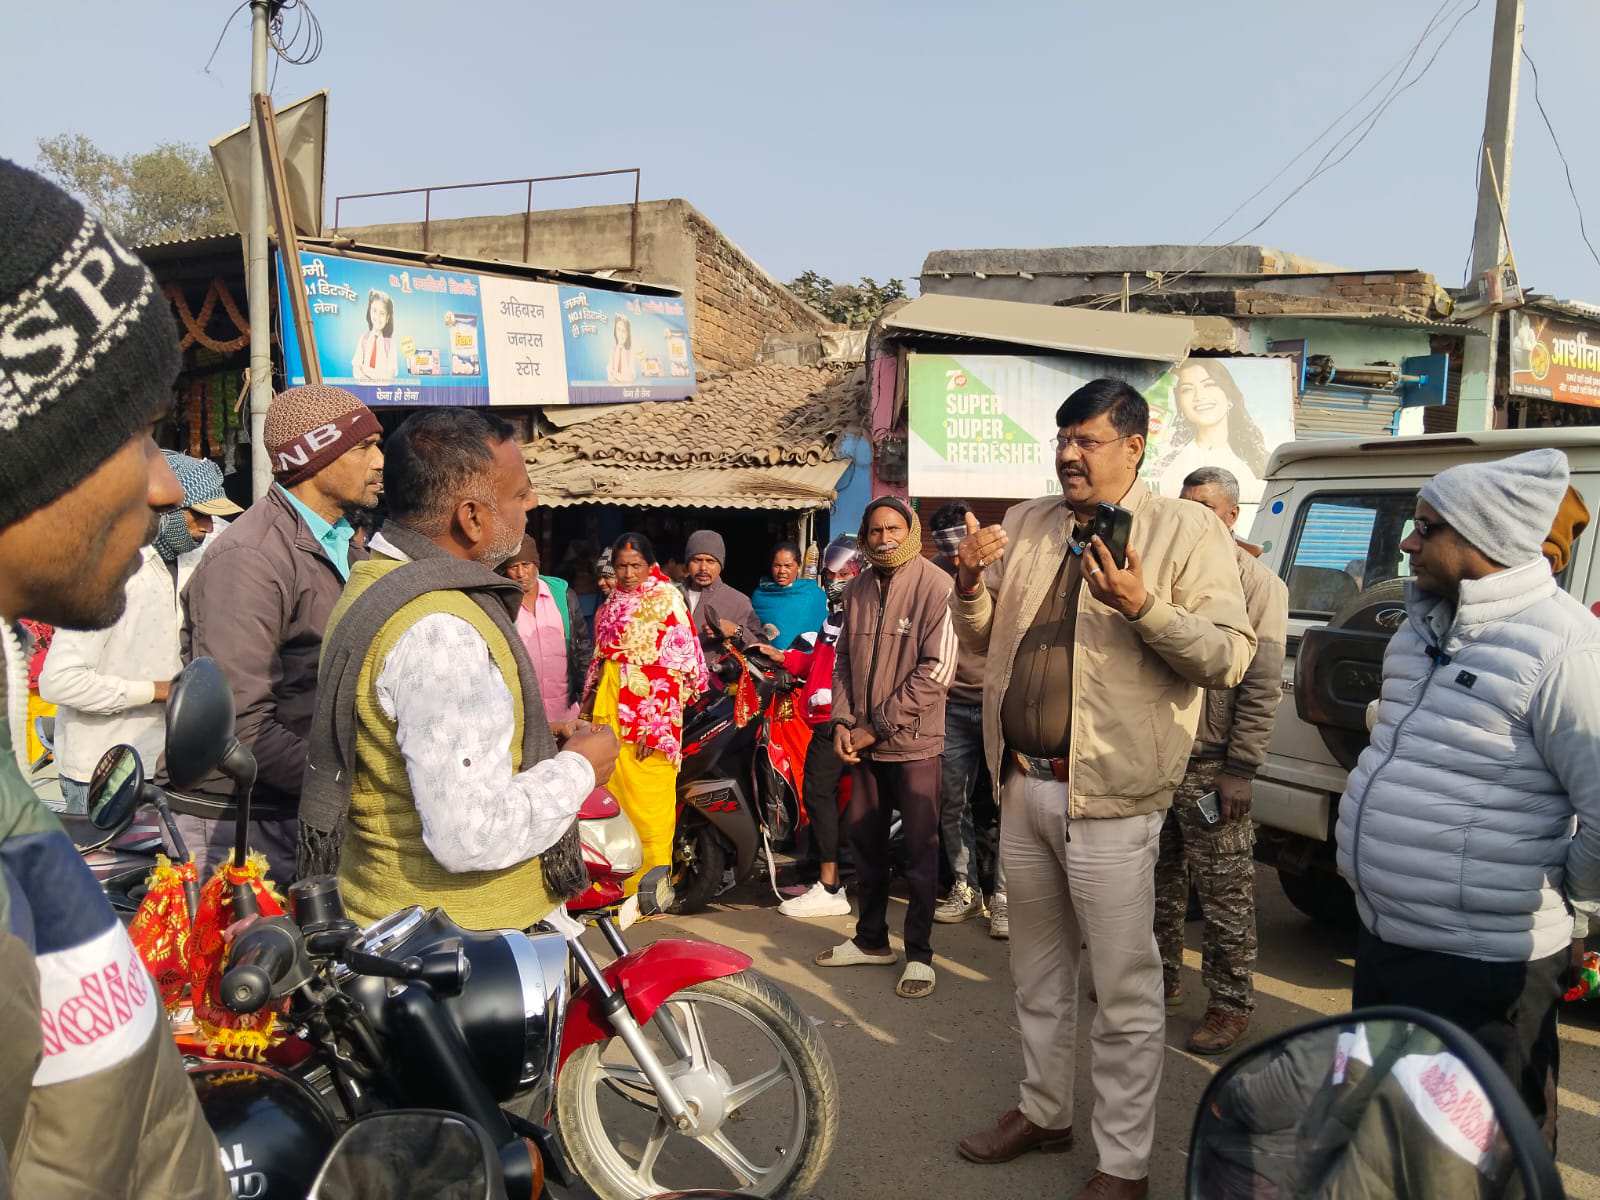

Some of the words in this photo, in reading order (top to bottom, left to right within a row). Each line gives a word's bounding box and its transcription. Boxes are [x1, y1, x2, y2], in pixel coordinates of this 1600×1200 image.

[313, 299, 338, 313] लेना
[506, 332, 544, 349] जनरल
[515, 355, 542, 377] स्टोर
[945, 393, 1002, 415] SUPER
[946, 418, 1004, 439] DUPER
[279, 424, 342, 471] NB
